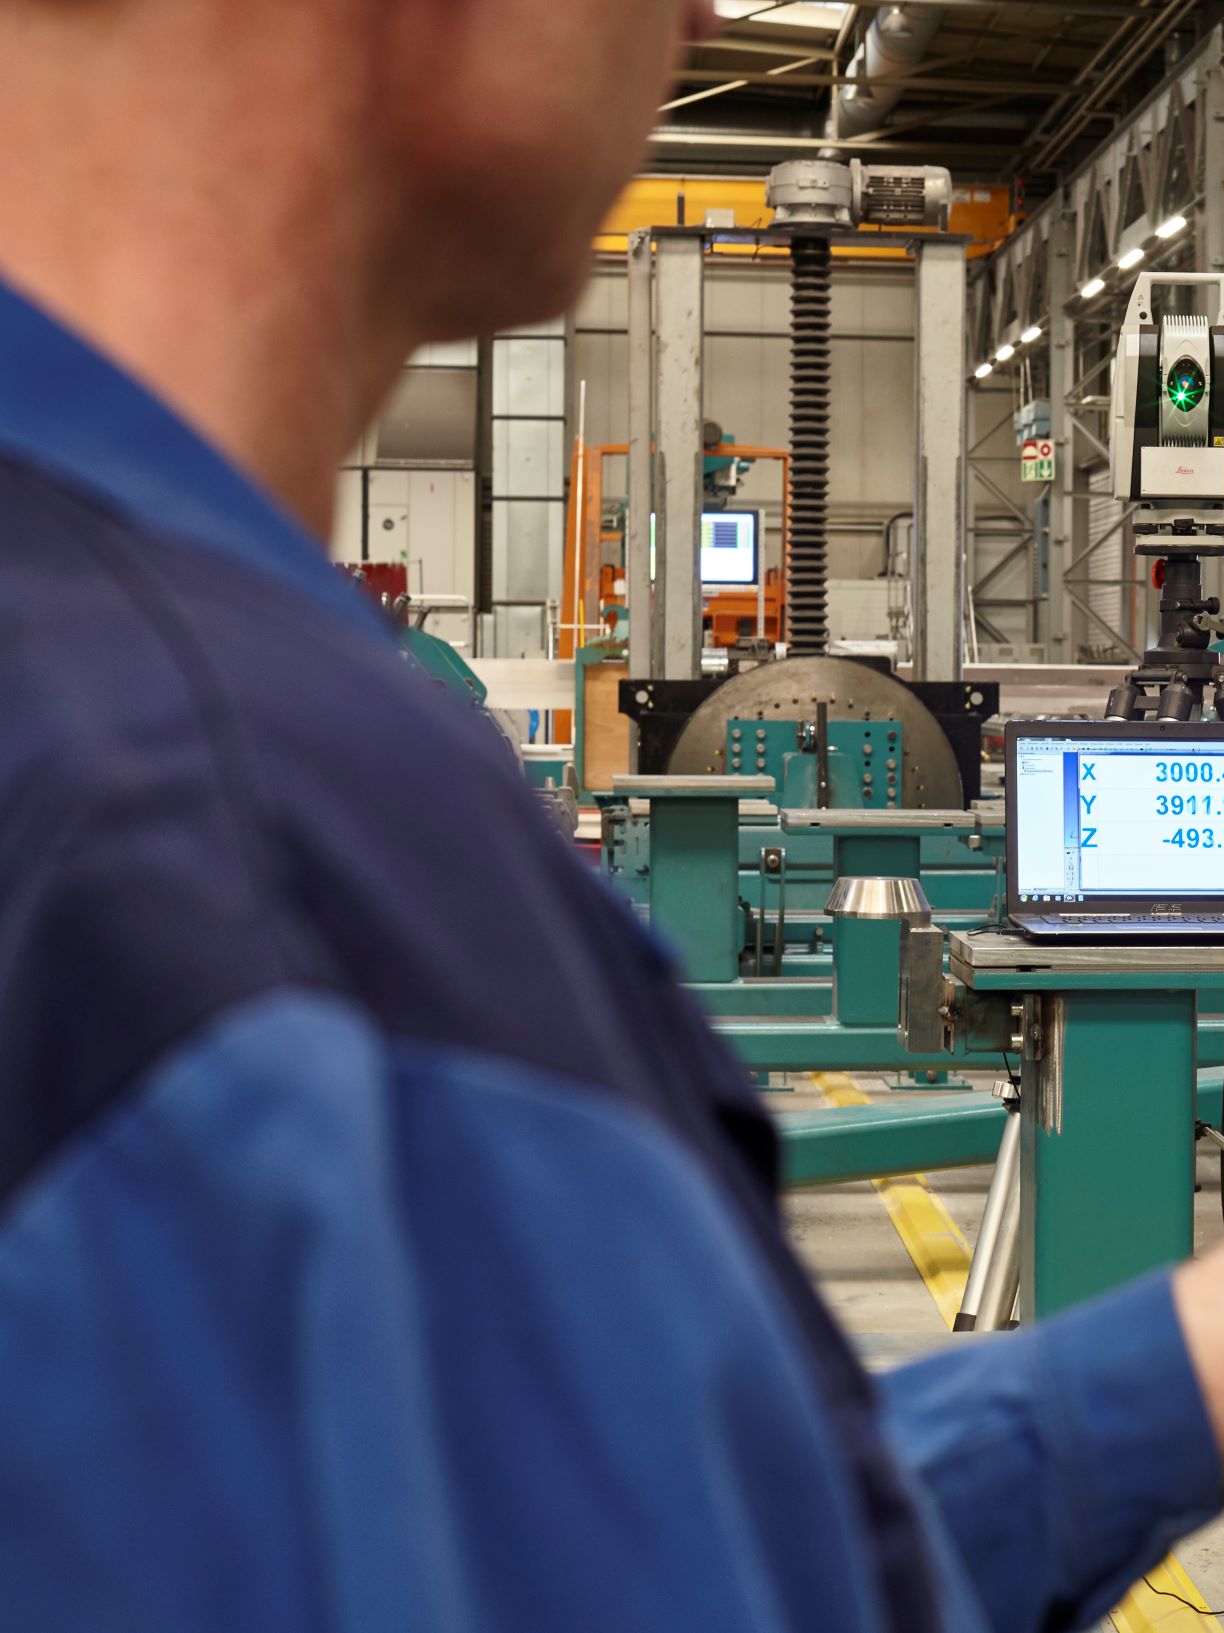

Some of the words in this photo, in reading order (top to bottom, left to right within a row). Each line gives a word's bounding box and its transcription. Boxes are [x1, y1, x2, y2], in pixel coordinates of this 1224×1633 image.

[1081, 763, 1097, 781] X
[1080, 795, 1097, 815] Y
[1080, 827, 1098, 848] Z
